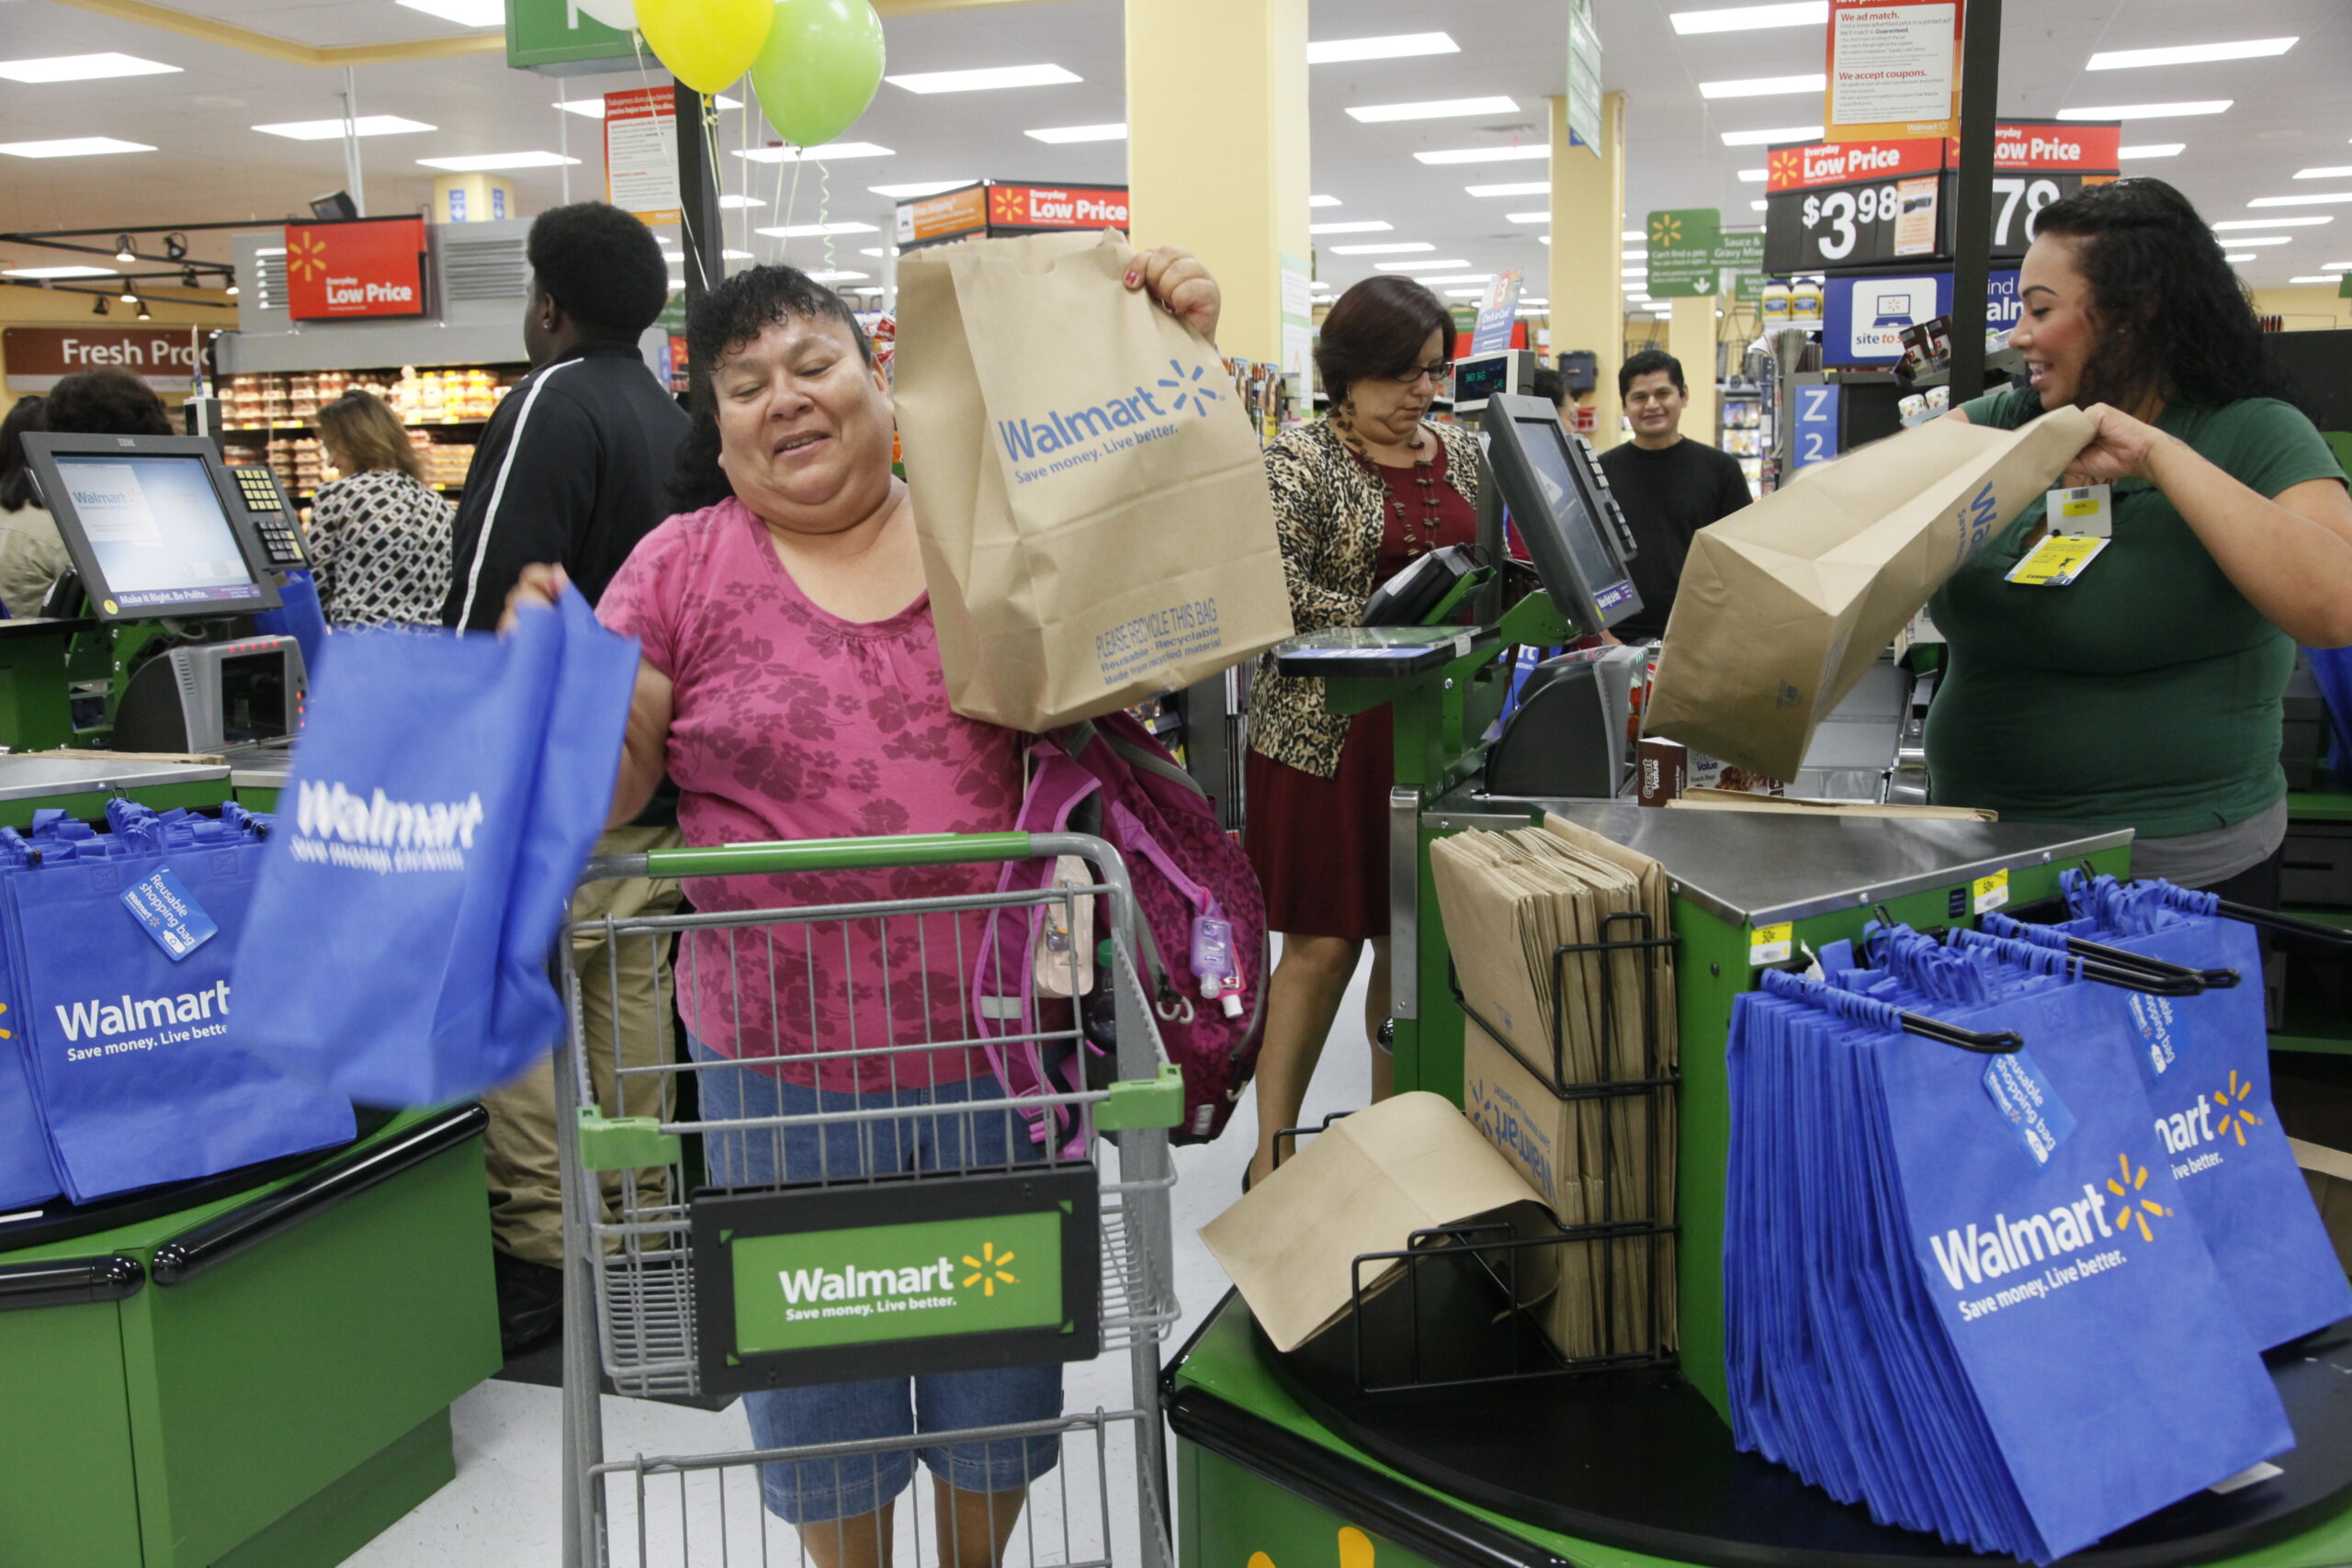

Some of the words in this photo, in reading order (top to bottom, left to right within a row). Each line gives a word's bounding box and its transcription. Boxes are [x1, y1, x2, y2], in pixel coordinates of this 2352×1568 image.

[1840, 13, 1855, 21] We
[1856, 12, 1868, 21] ad
[1869, 11, 1900, 20] match.
[1839, 72, 1854, 80] We
[1854, 70, 1884, 82] accept
[1885, 69, 1928, 79] coupons.
[1804, 144, 1840, 157] Everyday
[1804, 155, 1846, 179] Low
[1848, 147, 1900, 172] Price
[1994, 142, 2028, 161] ow
[2030, 137, 2082, 162] Price
[1029, 189, 1067, 201] Everyday
[1029, 200, 1073, 219] Low
[1076, 199, 1128, 221] Price
[1713, 247, 1741, 259] Gravy
[1724, 237, 1751, 247] Sauce
[326, 285, 364, 304] Low
[366, 282, 413, 303] Price
[1987, 276, 2014, 296] ind
[62, 338, 143, 365] Fresh
[1856, 332, 1880, 344] site
[1882, 333, 1894, 344] to
[1803, 389, 1828, 422] Z
[998, 386, 1167, 462] Walmart
[1014, 467, 1048, 485] Save
[1048, 448, 1102, 474] money.
[1102, 435, 1135, 455] Live
[1134, 423, 1179, 446] better.
[1804, 433, 1824, 461] 2
[73, 490, 127, 505] Walmart
[119, 594, 143, 604] Make
[150, 592, 173, 604] Right.
[173, 592, 184, 602] Be
[184, 590, 209, 601] Polite.
[1095, 625, 1132, 660] PLEASE
[1126, 610, 1170, 650] RECYCLE
[1169, 603, 1195, 632] THIS
[1194, 597, 1218, 626] BAG
[1101, 648, 1149, 672] Reusable
[1154, 626, 1221, 651] Recyclable
[1103, 669, 1129, 686] Made
[1148, 649, 1182, 668] recycled
[1184, 637, 1223, 657] material
[1643, 758, 1654, 799] Great
[1652, 759, 1660, 791] Value
[1697, 761, 1718, 772] Value
[297, 779, 484, 851] Walmart
[128, 891, 153, 919] Walmart
[150, 874, 188, 918] Reusable
[139, 883, 179, 929] shopping
[175, 923, 196, 946] bag
[55, 979, 231, 1042] Walmart
[67, 1046, 102, 1062] Save
[105, 1037, 158, 1055] money.
[160, 1030, 190, 1045] Live
[192, 1024, 228, 1040] bette
[2162, 1034, 2176, 1065] bag
[1996, 1057, 2038, 1124] shopping
[2035, 1118, 2056, 1152] bag
[2170, 1164, 2191, 1180] ive
[2187, 1152, 2224, 1173] better.
[1929, 1183, 2113, 1292] Walmart
[778, 1257, 955, 1304] Walmart
[1957, 1296, 1999, 1322] Save
[1996, 1279, 2050, 1310] money.
[2044, 1267, 2079, 1291] Live
[2075, 1248, 2128, 1279] better.
[786, 1306, 820, 1321] Save
[822, 1303, 875, 1317] money.
[876, 1298, 907, 1313] Live
[909, 1295, 958, 1310] better.
